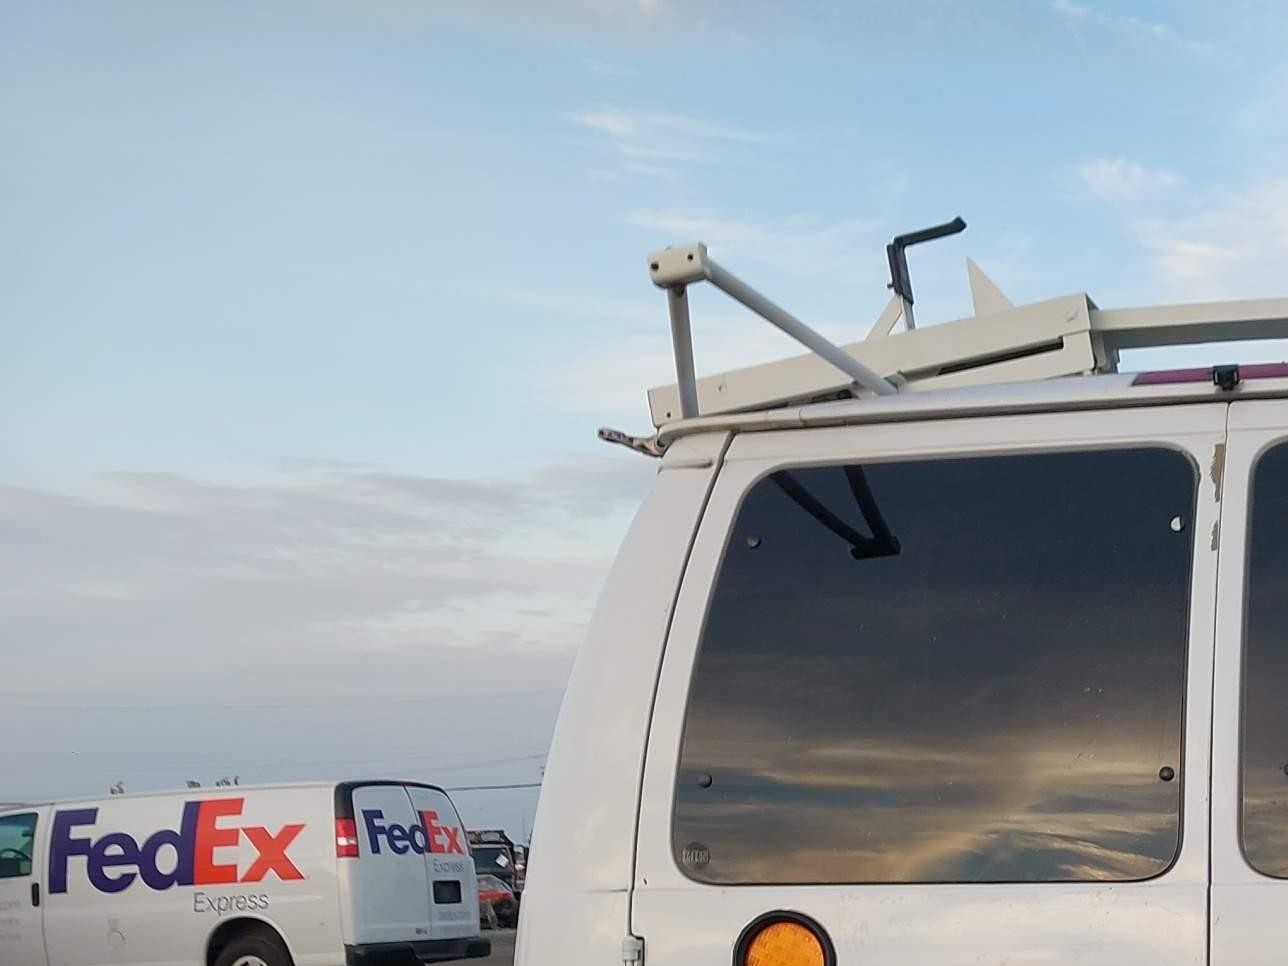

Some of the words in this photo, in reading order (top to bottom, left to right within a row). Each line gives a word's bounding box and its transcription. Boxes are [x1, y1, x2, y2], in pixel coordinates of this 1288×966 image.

[48, 798, 306, 894] FedEx
[361, 809, 465, 855] FedEx
[433, 858, 465, 873] Expss
[193, 891, 269, 917] Express
